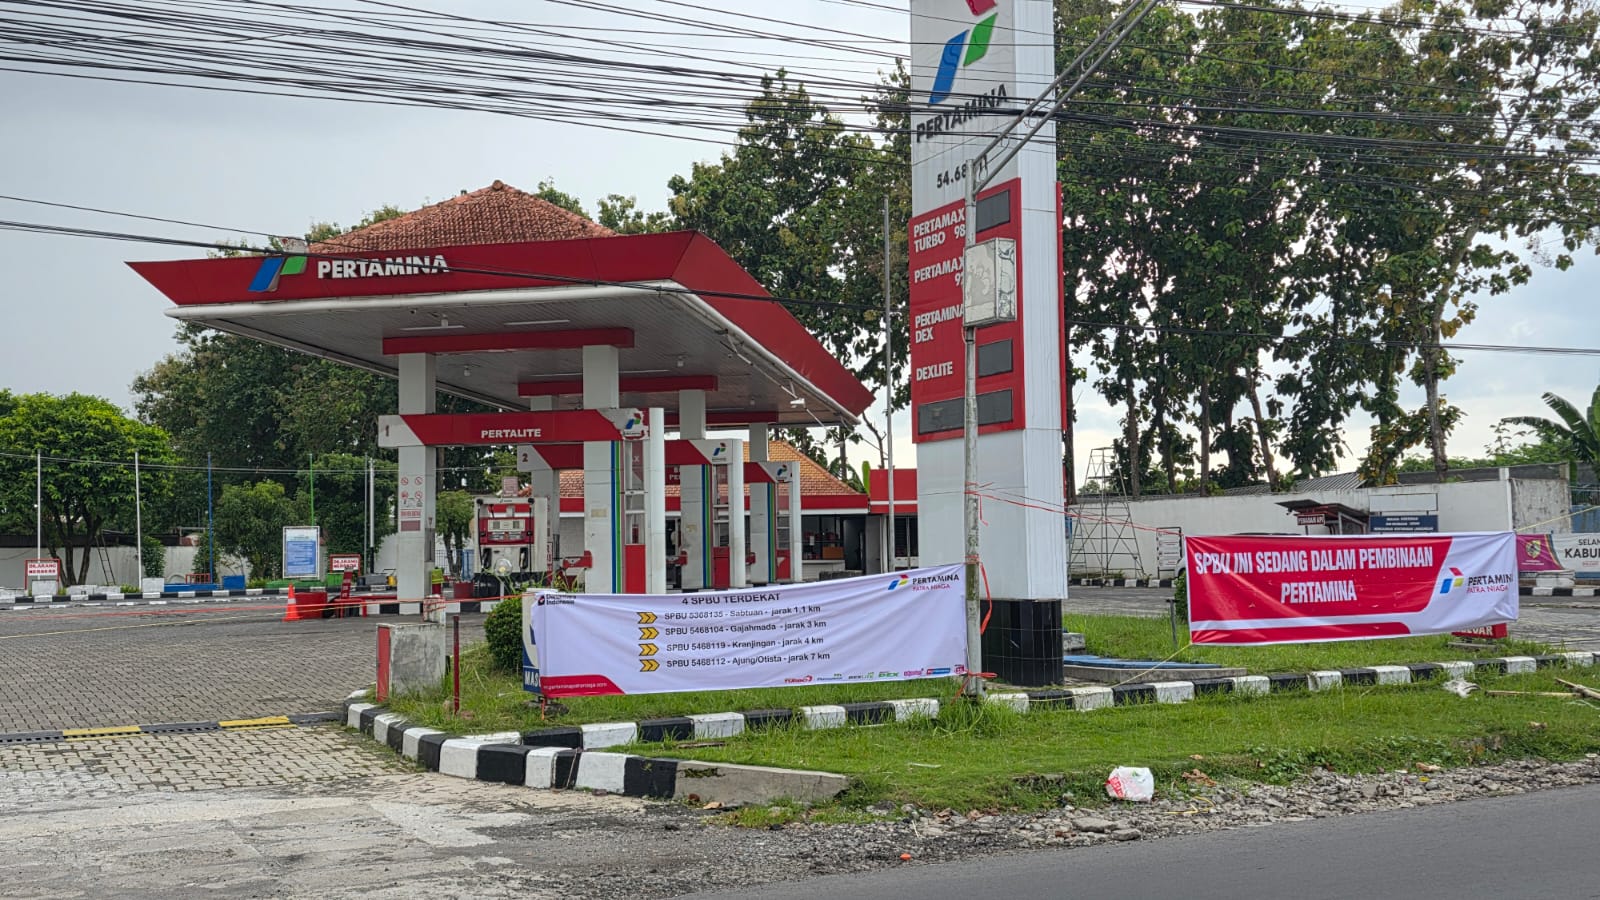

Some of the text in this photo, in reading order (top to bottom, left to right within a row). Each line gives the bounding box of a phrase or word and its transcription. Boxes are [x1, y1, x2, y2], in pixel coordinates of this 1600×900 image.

[916, 83, 1008, 144] PERTAMINA
[913, 207, 965, 239] PERTAMAX
[914, 223, 966, 253] TURBO 98
[317, 254, 449, 280] PERTAMINA
[915, 327, 934, 344] DEX
[916, 361, 953, 382] DEXLITE
[481, 428, 541, 439] PERTALITE
[521, 453, 529, 463] 2
[1195, 547, 1434, 575] SPBU INI SEDANG DALAM PEMBINAAN
[1564, 548, 1600, 559] KABU
[912, 574, 959, 584] PERTAMINA
[691, 596, 721, 605] SPBU
[723, 593, 781, 603] TERDEKAT
[1281, 580, 1357, 604] PERTAMINA
[664, 612, 687, 620] SPBU
[729, 609, 764, 618] Sabtuan
[771, 607, 792, 617] jarak
[807, 604, 821, 613] km
[665, 627, 688, 636] SPBU
[689, 626, 724, 635] 5468104
[730, 623, 777, 634] Gajahmada
[784, 622, 805, 631] jarak
[814, 620, 827, 629] km
[666, 643, 690, 652] SPBU
[691, 641, 726, 651] 5468119
[732, 641, 776, 651] Kranjingan
[782, 639, 803, 647] jarak
[811, 636, 824, 645] km
[666, 659, 690, 668] SPBU
[691, 657, 726, 667] 5468112
[732, 656, 782, 666] Ajung/Otista
[787, 654, 808, 664] jarak
[810, 653, 816, 661] 7
[817, 652, 831, 661] km
[524, 671, 540, 687] MAS
